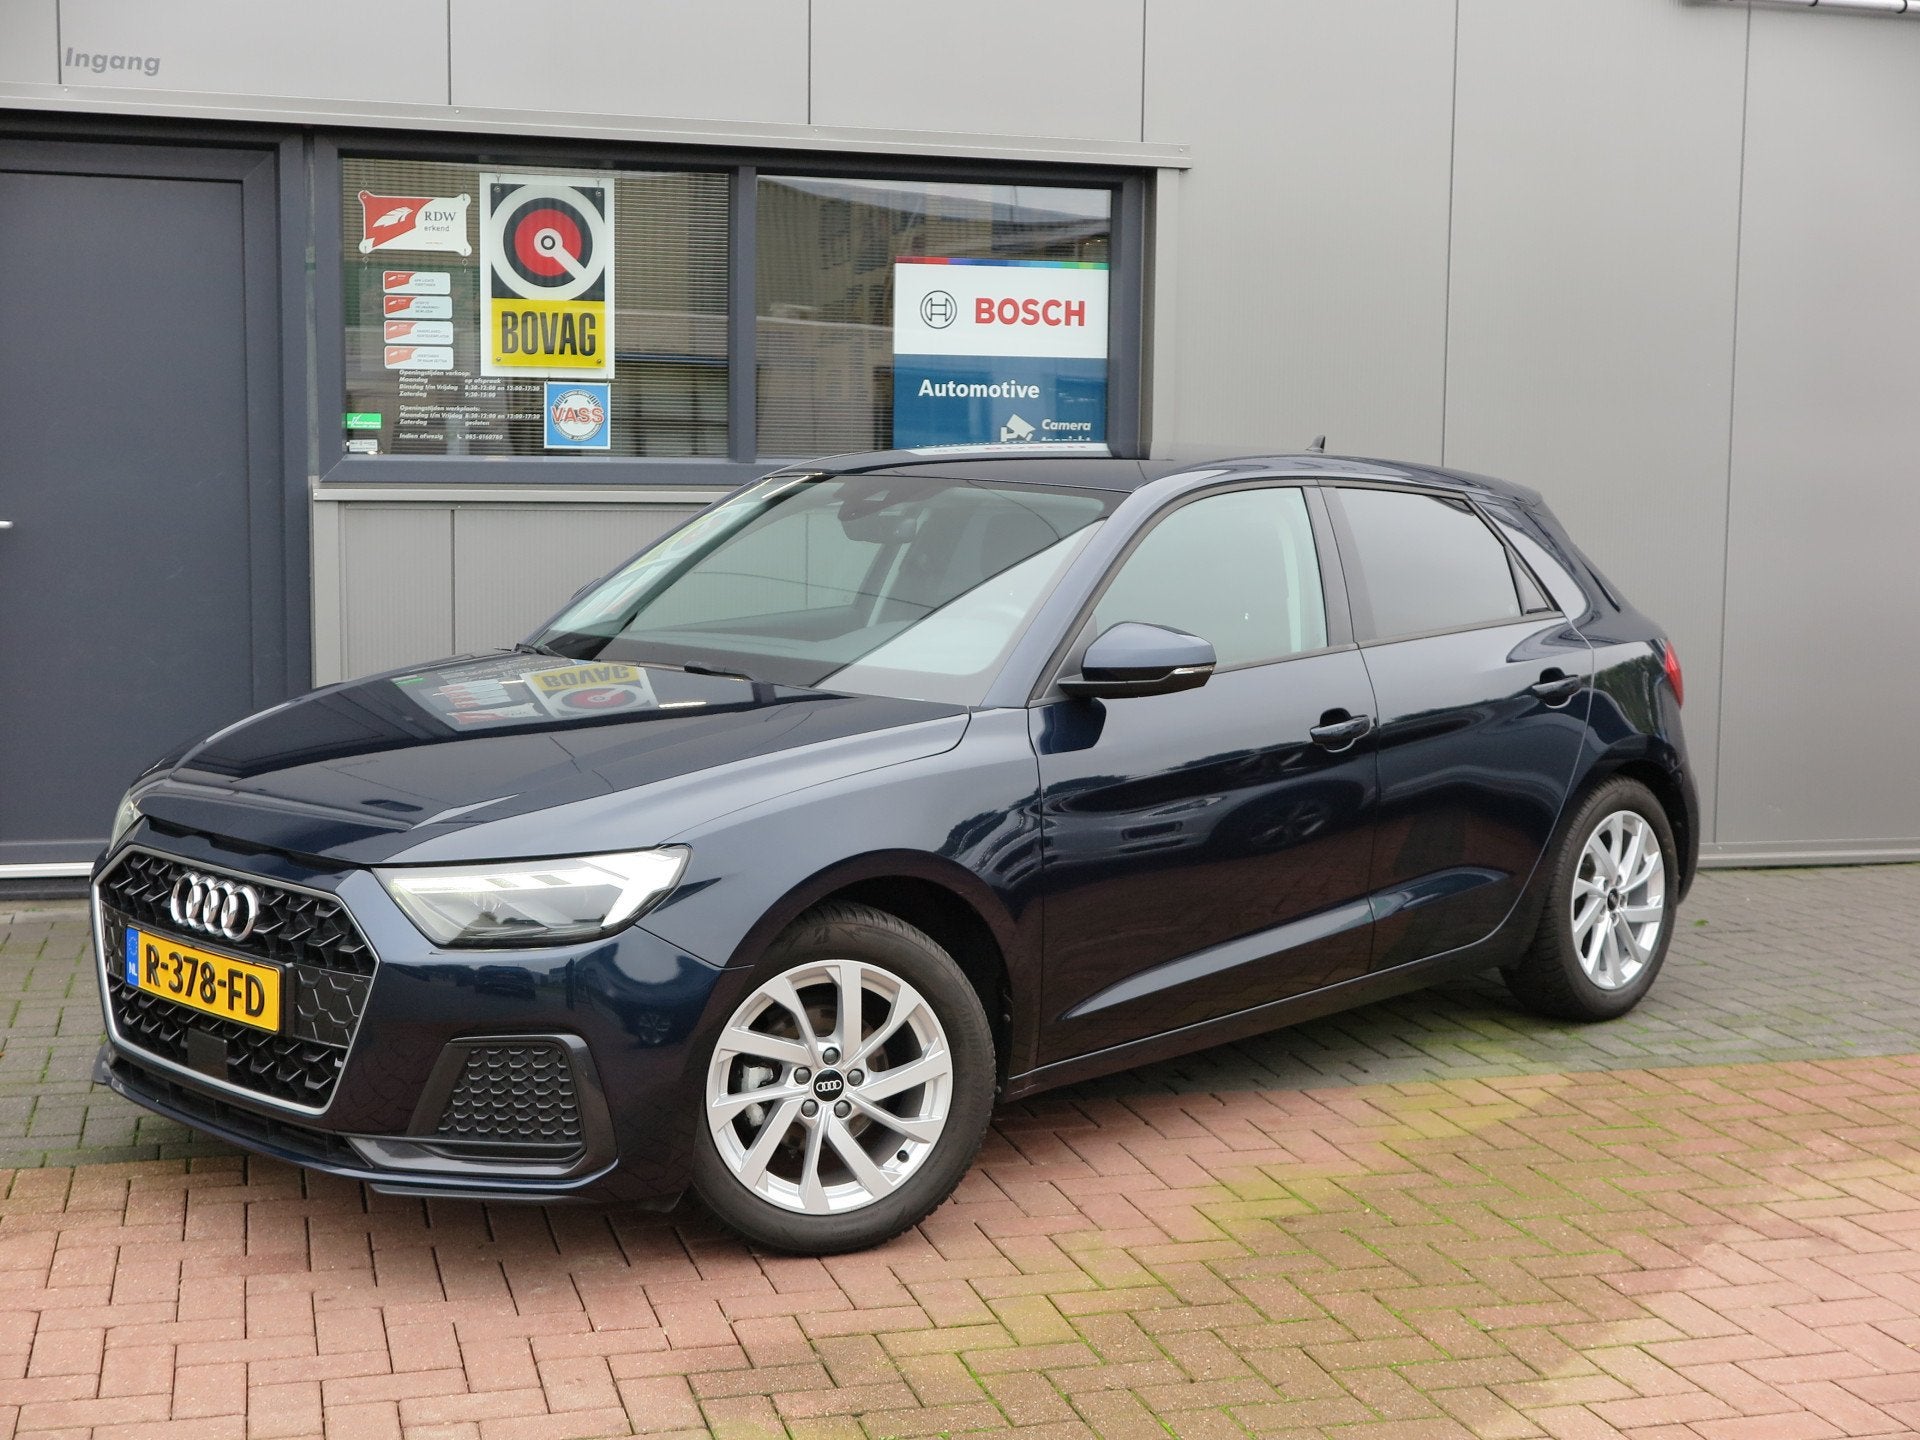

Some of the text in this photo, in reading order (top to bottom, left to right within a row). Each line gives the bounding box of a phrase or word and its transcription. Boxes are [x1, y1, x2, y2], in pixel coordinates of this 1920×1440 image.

[65, 47, 160, 76] Ingang
[424, 211, 456, 221] RDW
[974, 297, 1086, 327] BOSCH
[501, 310, 596, 356] BOVAG
[918, 379, 1040, 399] Automotive
[552, 406, 604, 423] VASS
[1041, 418, 1091, 431] Camera
[145, 942, 265, 1018] R-378-FD
